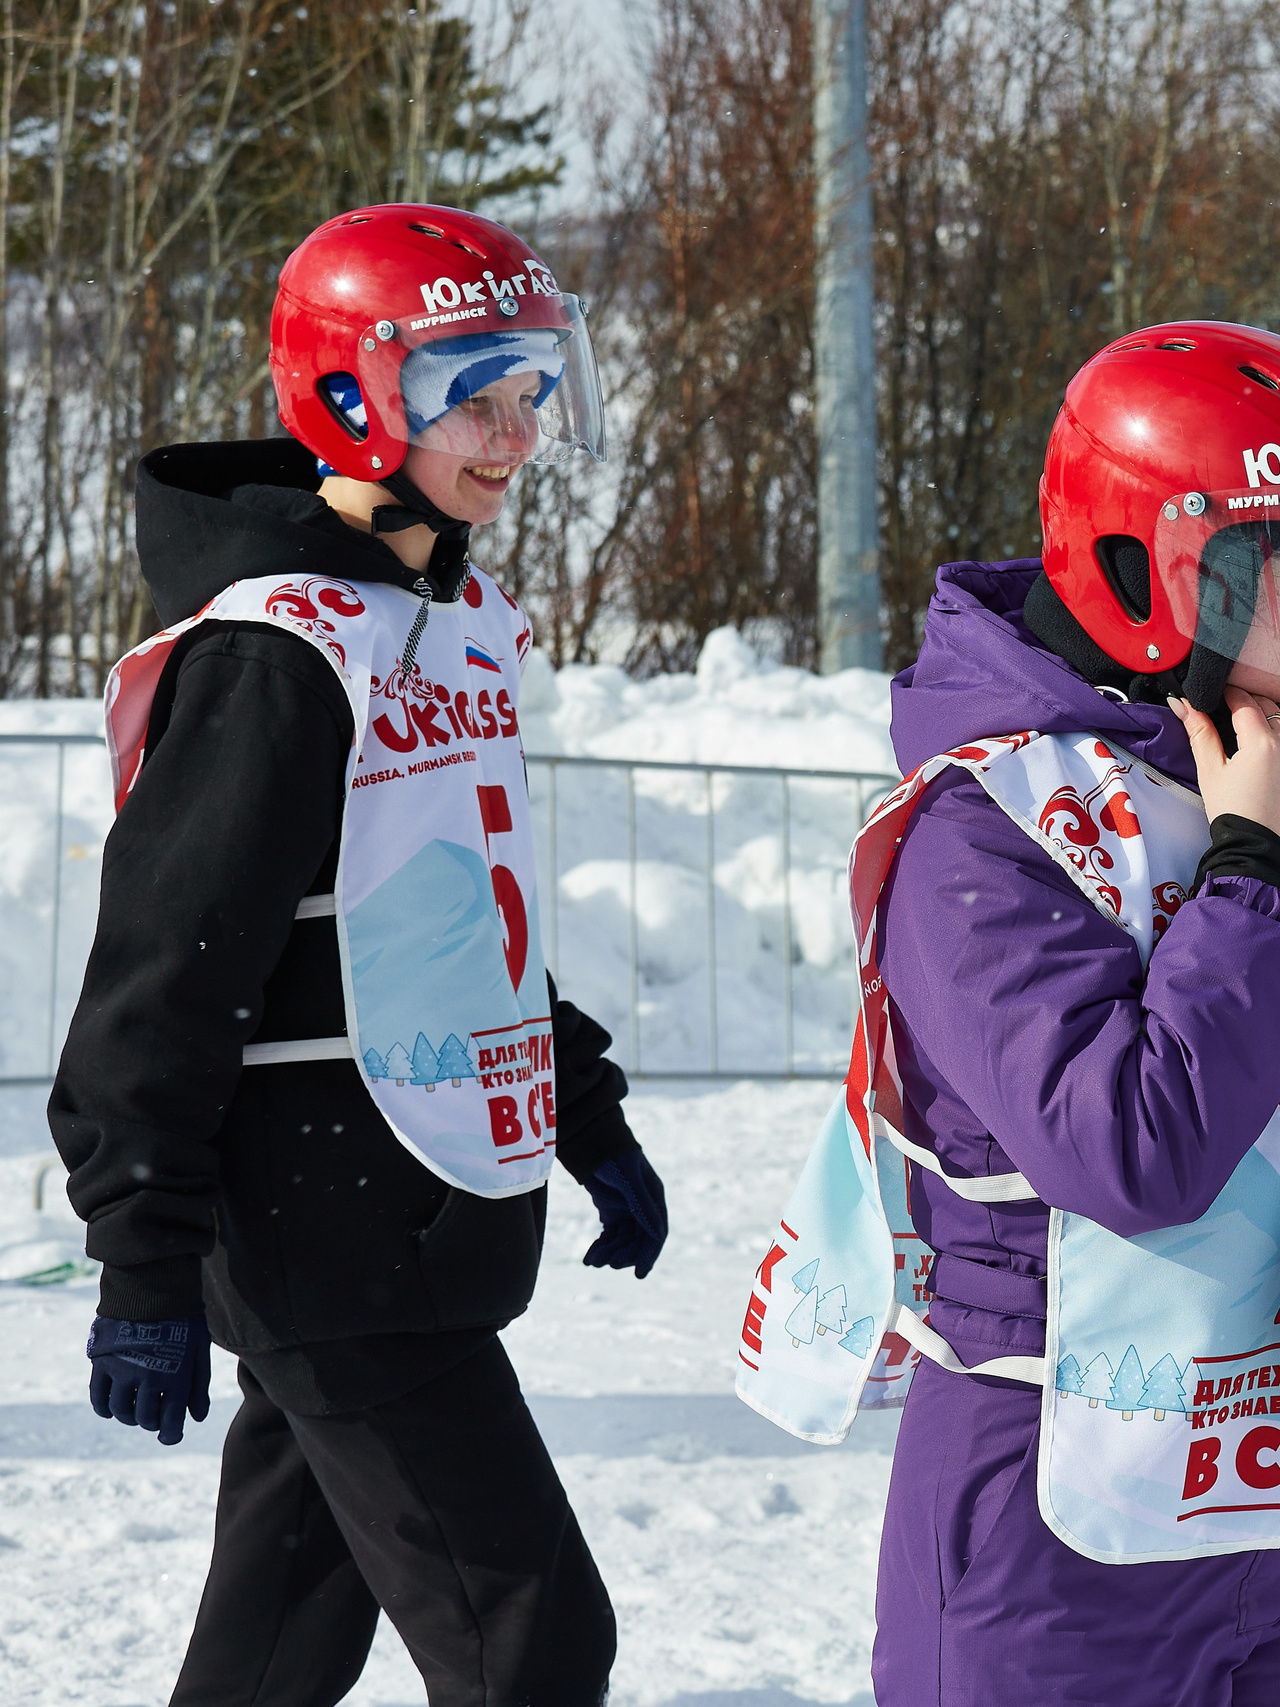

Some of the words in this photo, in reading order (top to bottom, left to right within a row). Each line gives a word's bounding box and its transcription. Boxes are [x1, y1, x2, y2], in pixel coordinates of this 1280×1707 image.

[410, 306, 488, 331] МУРМАНСК
[351, 767, 405, 790] RUSSIA,
[407, 751, 463, 776] MURMANSK
[478, 1044, 518, 1071] ДЛЯ
[481, 1069, 514, 1090] КТО
[487, 1095, 523, 1148] В
[1193, 1373, 1246, 1406] ДЛЯ
[1192, 1405, 1229, 1430] КТО
[1182, 1436, 1222, 1500] В
